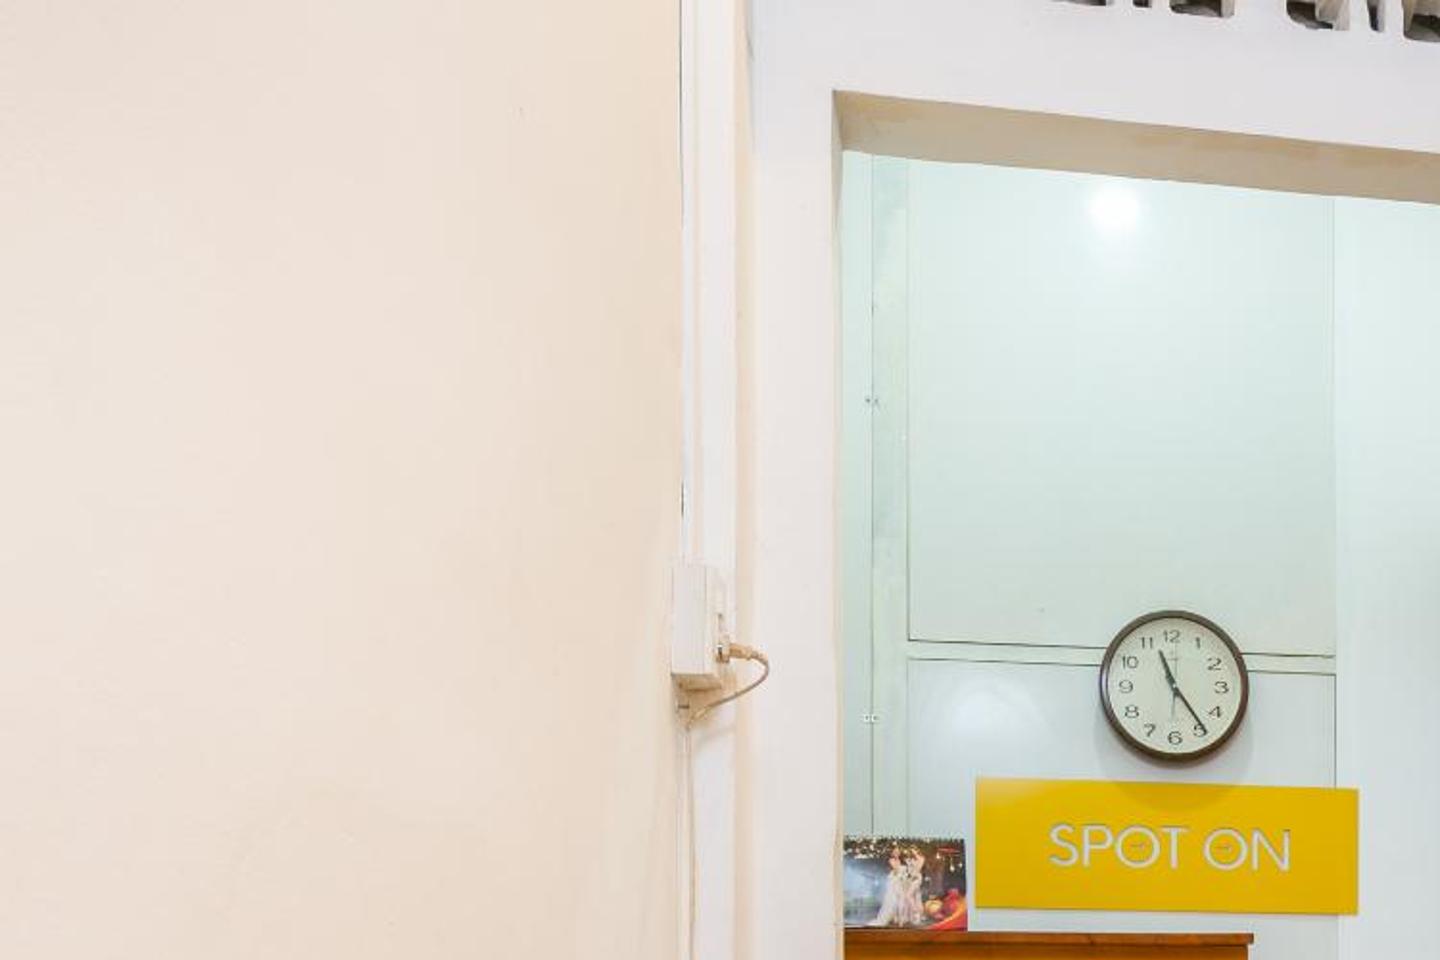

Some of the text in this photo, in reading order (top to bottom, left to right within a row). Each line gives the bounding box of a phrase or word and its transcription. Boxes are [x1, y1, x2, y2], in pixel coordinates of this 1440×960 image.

[1141, 637, 1153, 648] 11
[1163, 629, 1181, 643] 12
[1122, 656, 1139, 669] 10
[1207, 657, 1222, 671] 2
[1118, 680, 1134, 694] 9
[1214, 681, 1229, 694] 3
[1124, 705, 1140, 718] 8
[1208, 706, 1222, 718] 4
[1144, 724, 1156, 737] 7
[1167, 731, 1183, 745] 6
[1049, 822, 1291, 872] SPOT ON
